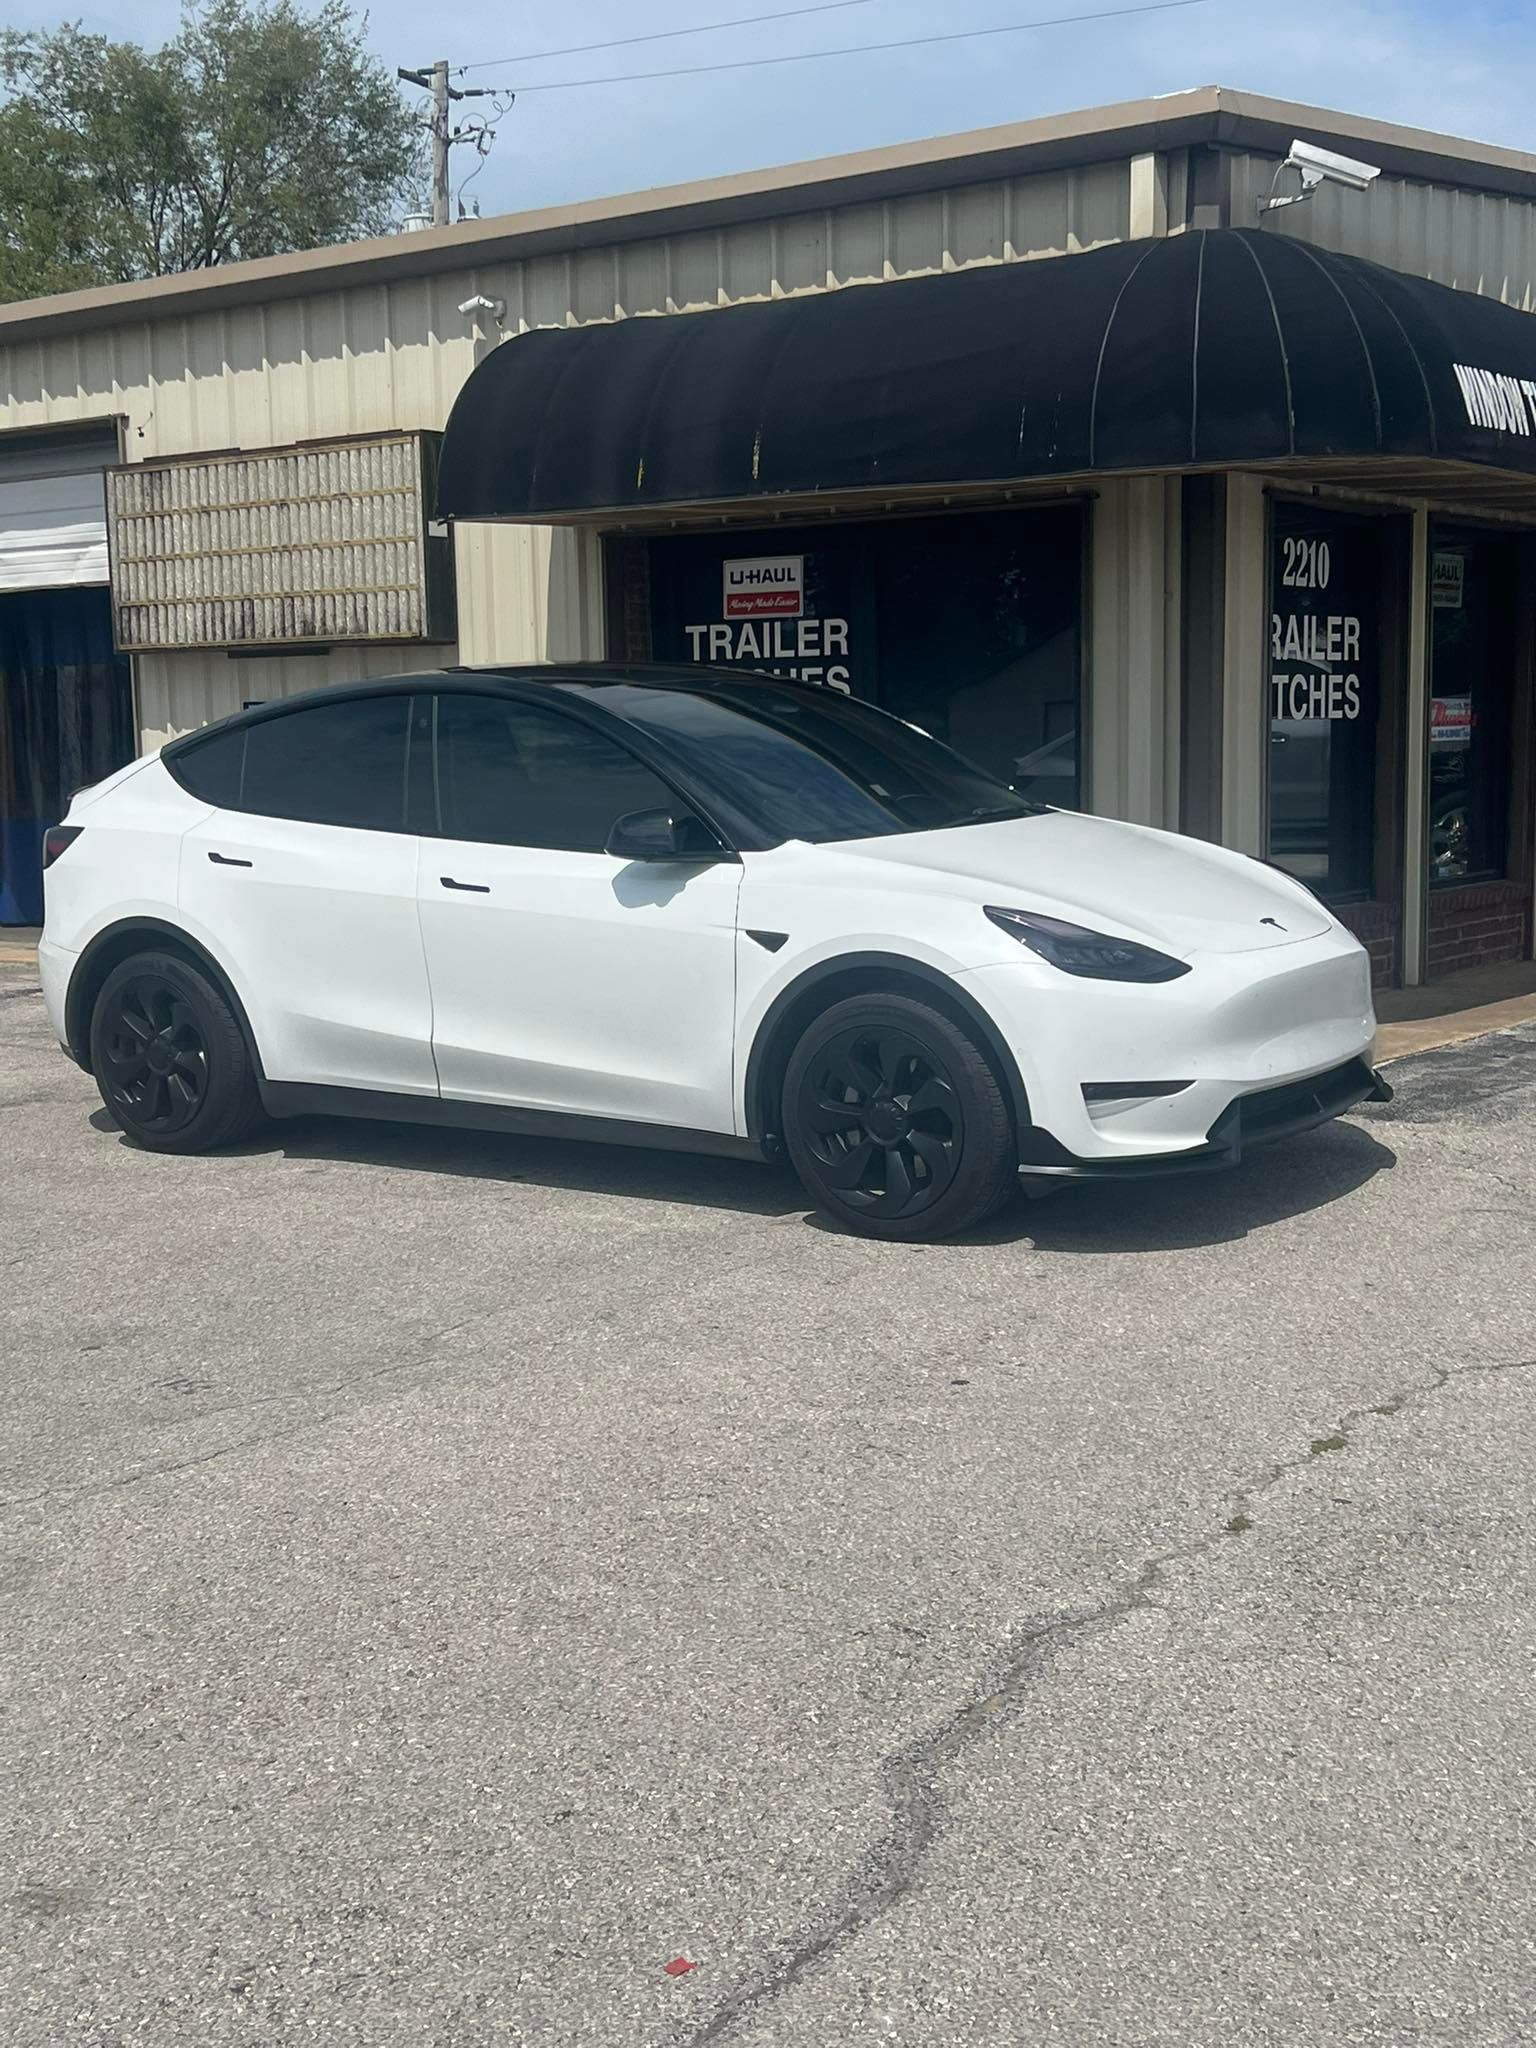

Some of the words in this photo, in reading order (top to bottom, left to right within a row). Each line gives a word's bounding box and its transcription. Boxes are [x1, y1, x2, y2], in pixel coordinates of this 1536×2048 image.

[1453, 363, 1530, 436] WINDOW
[730, 568, 796, 585] U-HAUL
[1282, 536, 1330, 589] 2210
[729, 598, 754, 611] Moving
[754, 598, 774, 608] Made
[774, 596, 798, 607] Easier
[685, 618, 849, 661] TRAILER
